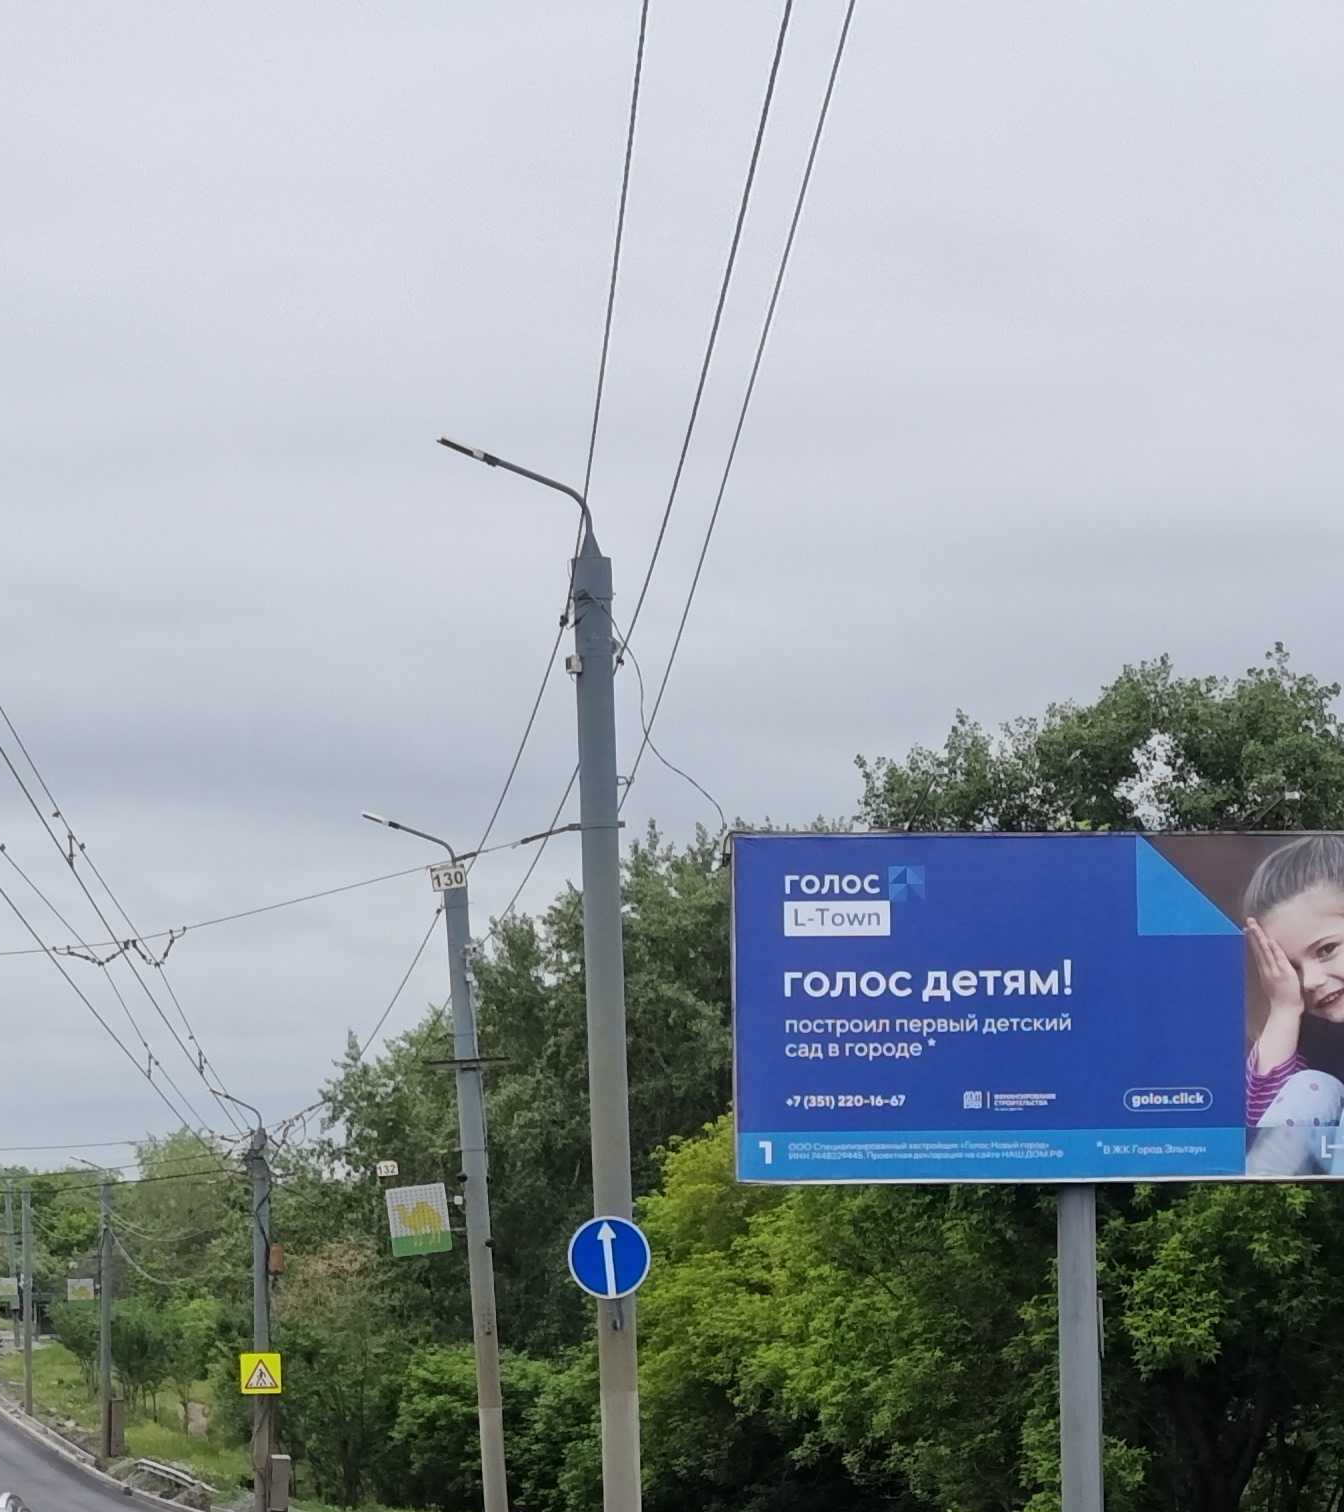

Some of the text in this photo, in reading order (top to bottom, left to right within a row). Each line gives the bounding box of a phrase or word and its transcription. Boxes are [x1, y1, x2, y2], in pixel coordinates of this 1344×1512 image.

[432, 870, 464, 888] 130
[784, 874, 881, 895] голос
[794, 908, 881, 927] L-Town
[783, 959, 1073, 1002] голос детям!
[785, 1012, 1072, 1037] построил первый детский
[785, 1042, 824, 1060] сад
[828, 1043, 840, 1057] в
[786, 1094, 906, 1110] +7 (351) 220-16-67
[1131, 1092, 1205, 1108] golos.click
[788, 1142, 812, 1151] ООО
